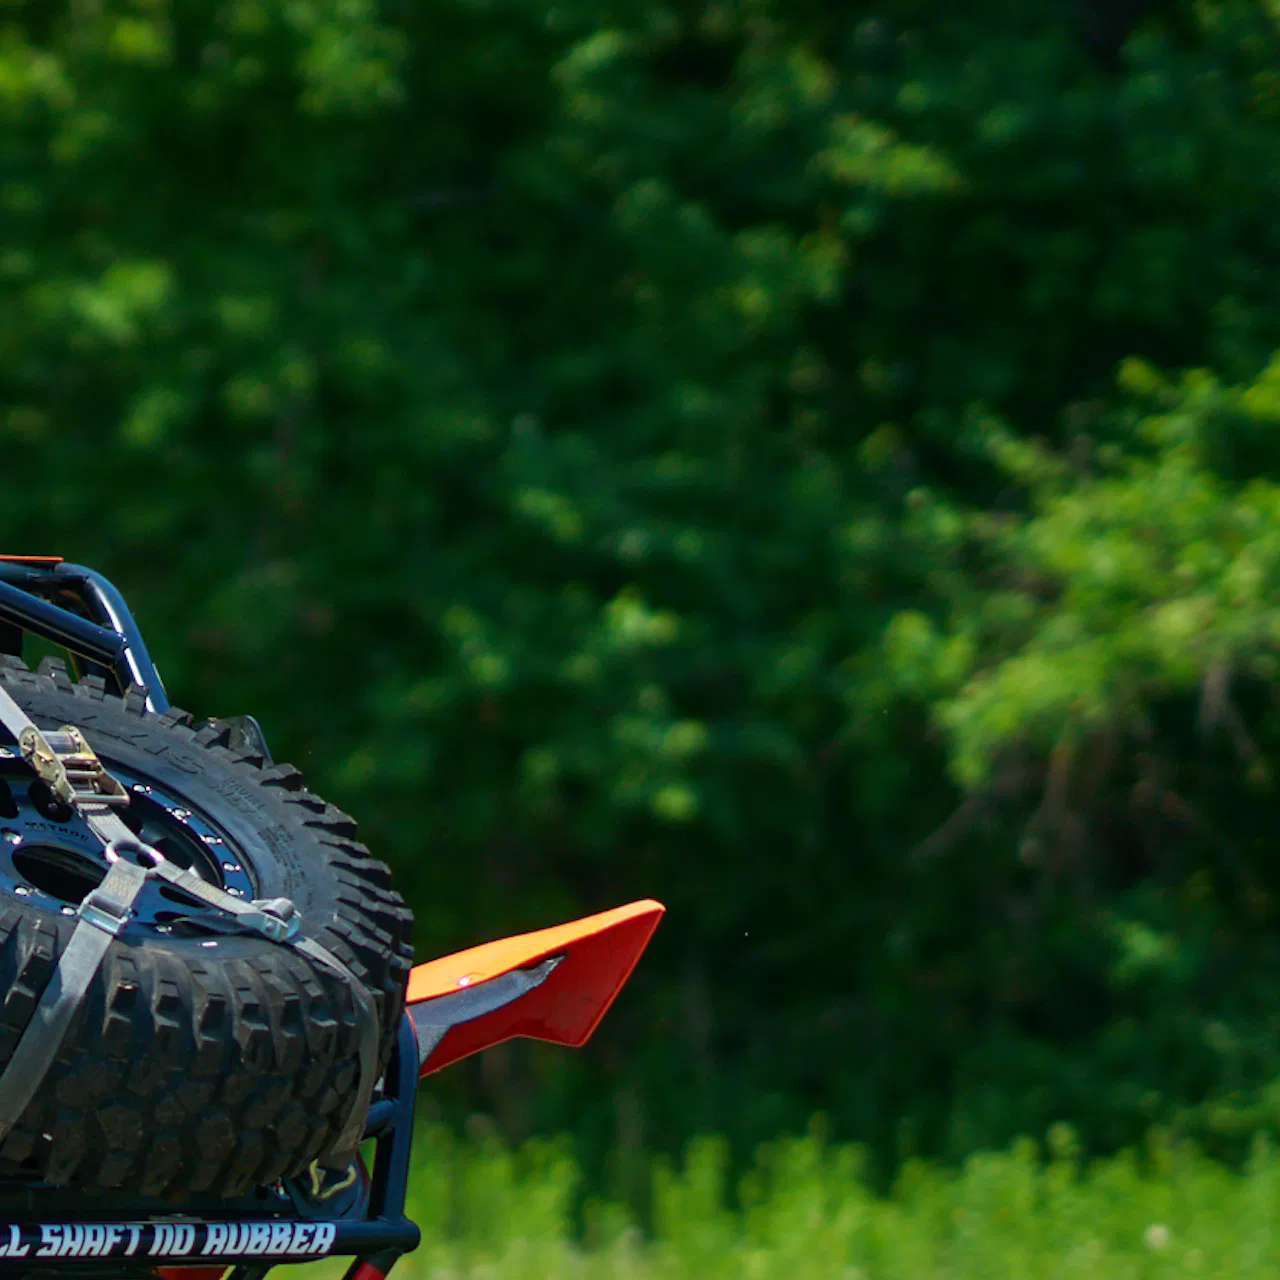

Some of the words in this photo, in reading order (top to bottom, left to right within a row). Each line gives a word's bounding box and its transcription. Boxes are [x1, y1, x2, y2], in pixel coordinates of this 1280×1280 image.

[35, 1224, 145, 1257] SHAFT
[147, 1223, 196, 1257] NO
[200, 1222, 337, 1256] RUBBER
